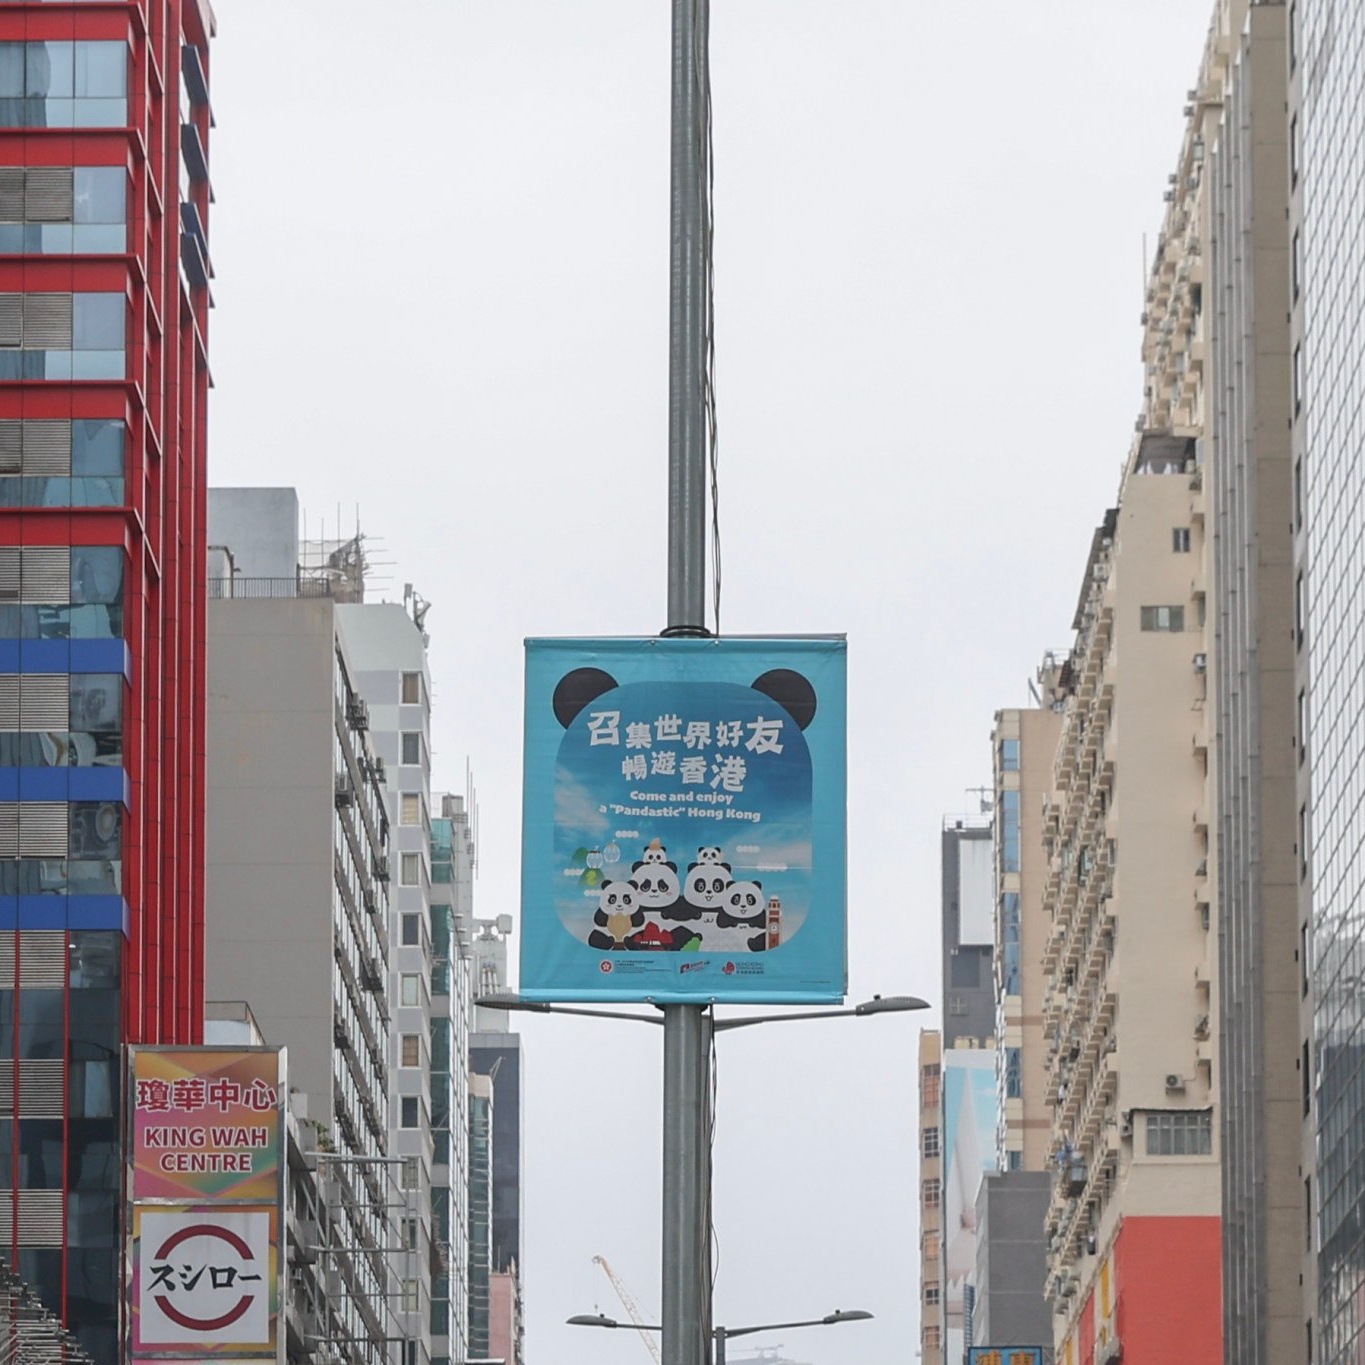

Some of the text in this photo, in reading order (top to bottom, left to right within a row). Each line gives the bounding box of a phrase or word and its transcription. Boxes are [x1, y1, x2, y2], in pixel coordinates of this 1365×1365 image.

[586, 710, 785, 756] 召集世界好友
[621, 750, 748, 794] 暢遊香港
[629, 790, 734, 806] Come and enjoy
[599, 805, 608, 814] a
[687, 807, 723, 822] Hong
[725, 808, 762, 824] Kong
[135, 1077, 278, 1113] 瓊華中心
[143, 1127, 268, 1149] KING WAH
[160, 1153, 253, 1173] CENTRE
[146, 1262, 263, 1294] スシロー
